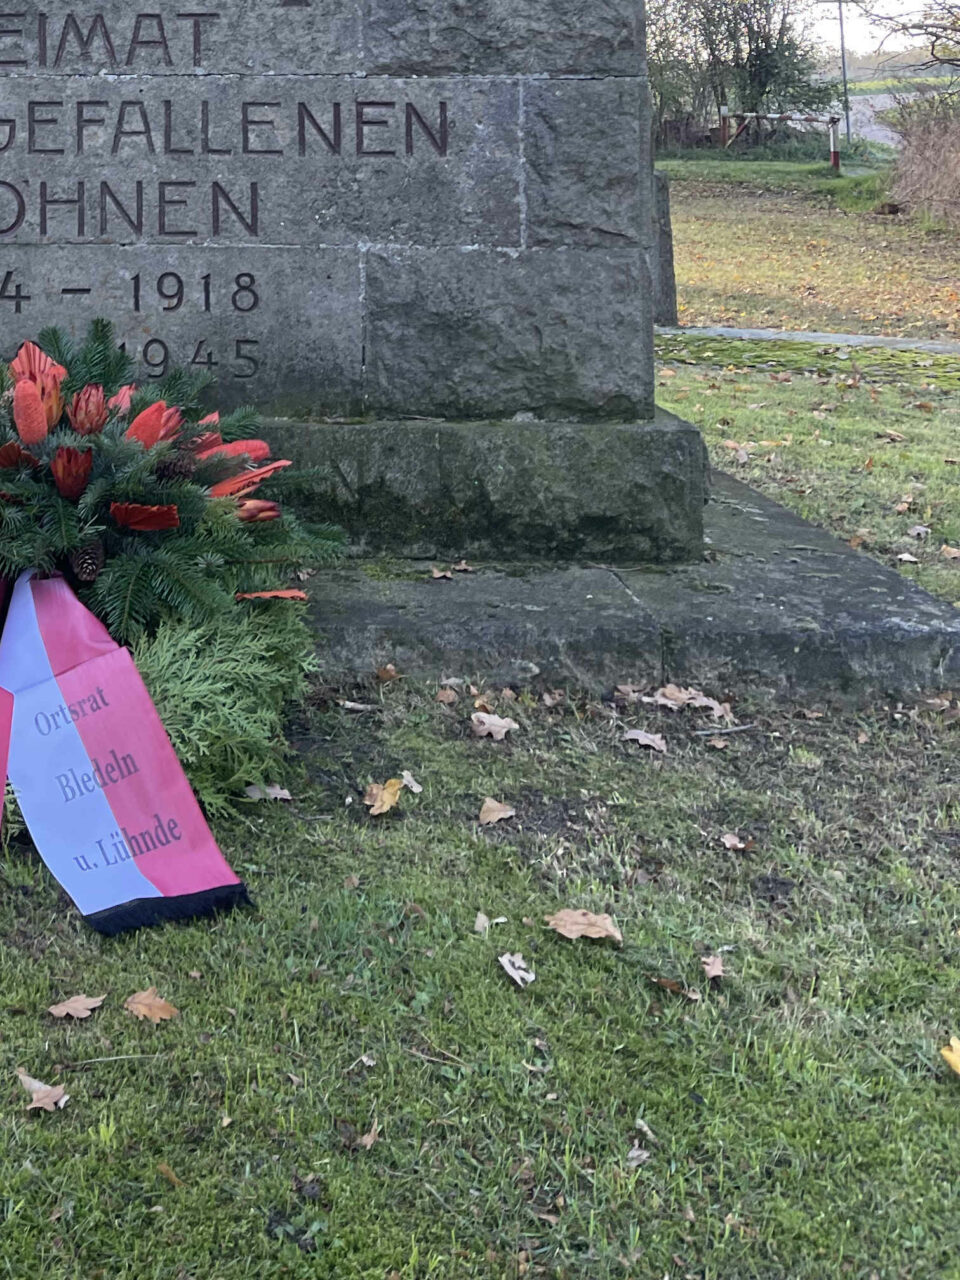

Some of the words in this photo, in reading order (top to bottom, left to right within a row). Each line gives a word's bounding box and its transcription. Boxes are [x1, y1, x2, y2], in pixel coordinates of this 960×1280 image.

[131, 271, 260, 313] 1918
[118, 337, 260, 379] 945
[34, 686, 110, 736] Ortsrat
[55, 749, 140, 803] Bledeln
[73, 853, 99, 872] u.
[95, 813, 183, 867] Lühnde
